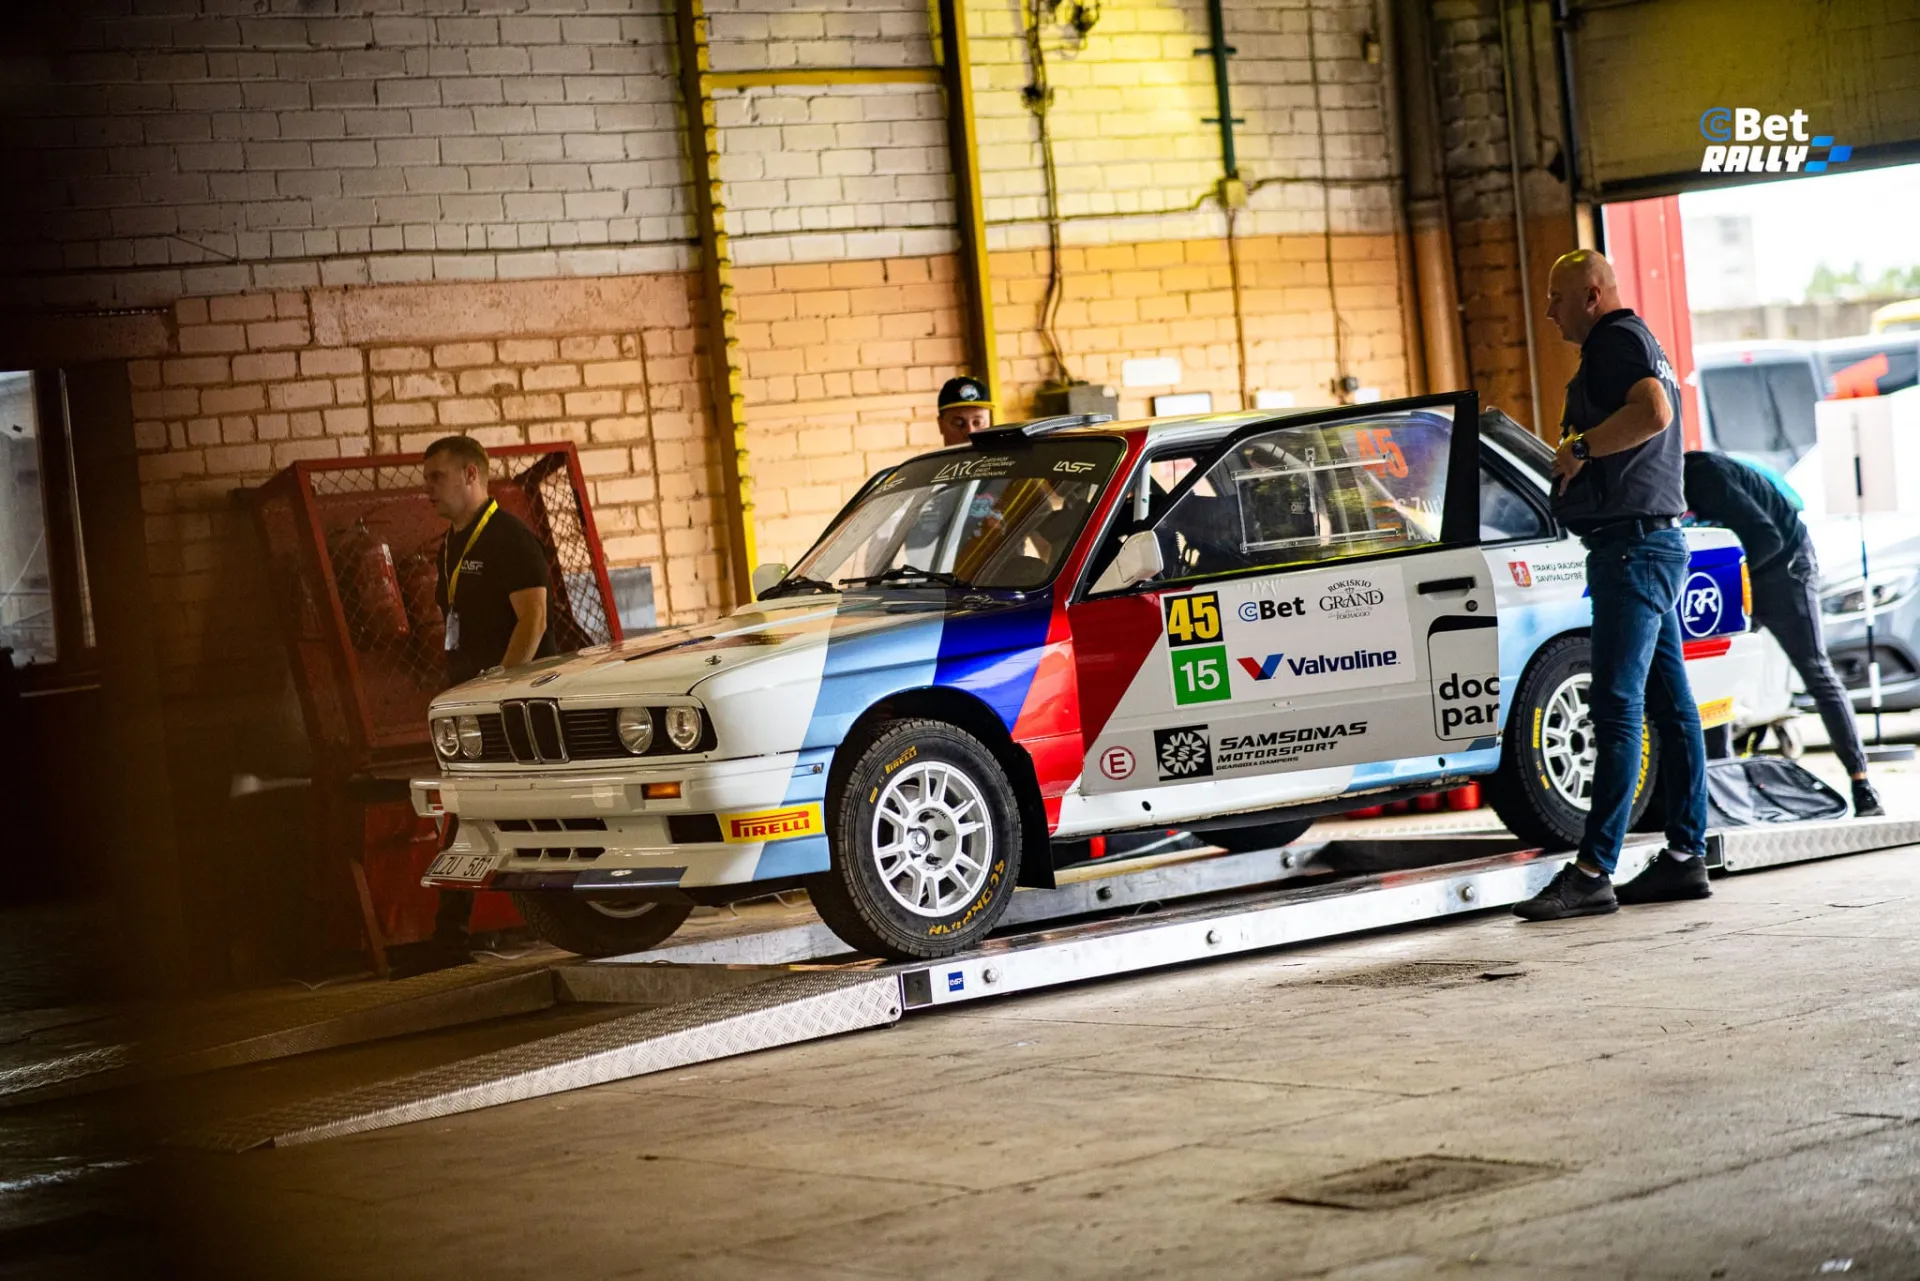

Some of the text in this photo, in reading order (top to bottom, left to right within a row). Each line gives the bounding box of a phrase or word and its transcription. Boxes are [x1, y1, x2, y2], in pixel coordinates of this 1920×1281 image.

[1355, 428, 1409, 479] 45
[1053, 461, 1096, 474] LASF
[1319, 589, 1384, 612] GRAND
[1168, 595, 1220, 641] 45
[1180, 659, 1220, 692] 15
[1287, 650, 1398, 676] Valvoline
[1439, 672, 1500, 701] doc
[1442, 703, 1500, 736] par
[1219, 721, 1368, 751] SAMSONAS
[1109, 753, 1127, 774] E
[1217, 741, 1338, 763] MOTORSPORT
[1259, 756, 1299, 766] DAMPERS
[730, 810, 810, 838] PIRELLI
[431, 856, 464, 875] LZU
